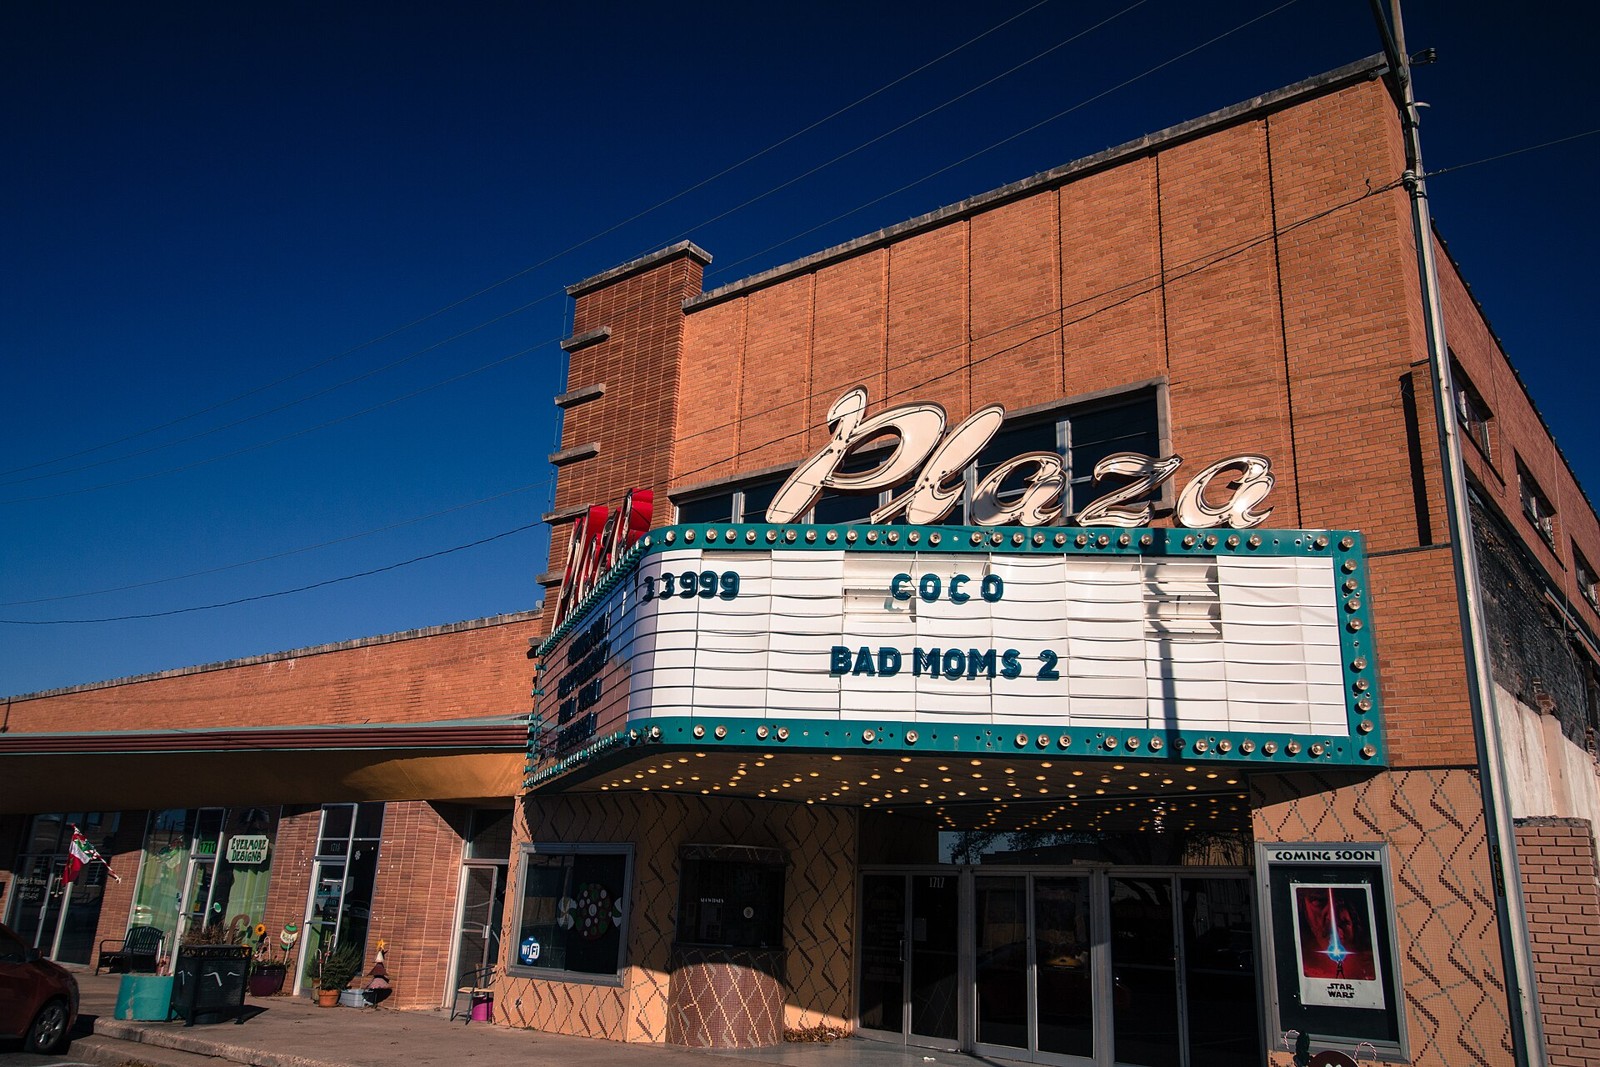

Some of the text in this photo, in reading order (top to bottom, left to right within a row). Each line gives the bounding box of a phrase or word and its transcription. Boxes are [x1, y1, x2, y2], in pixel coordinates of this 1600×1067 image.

[765, 384, 1278, 530] Plaza
[890, 572, 1004, 605] COCO
[829, 645, 1060, 682] BAD MOMS 2
[200, 842, 216, 853] 1711
[231, 838, 267, 851] EVERMORE
[231, 850, 262, 862] DESIGNS
[1275, 850, 1375, 861] COMING SOON
[929, 876, 945, 889] 1717
[1327, 983, 1354, 991] STAR
